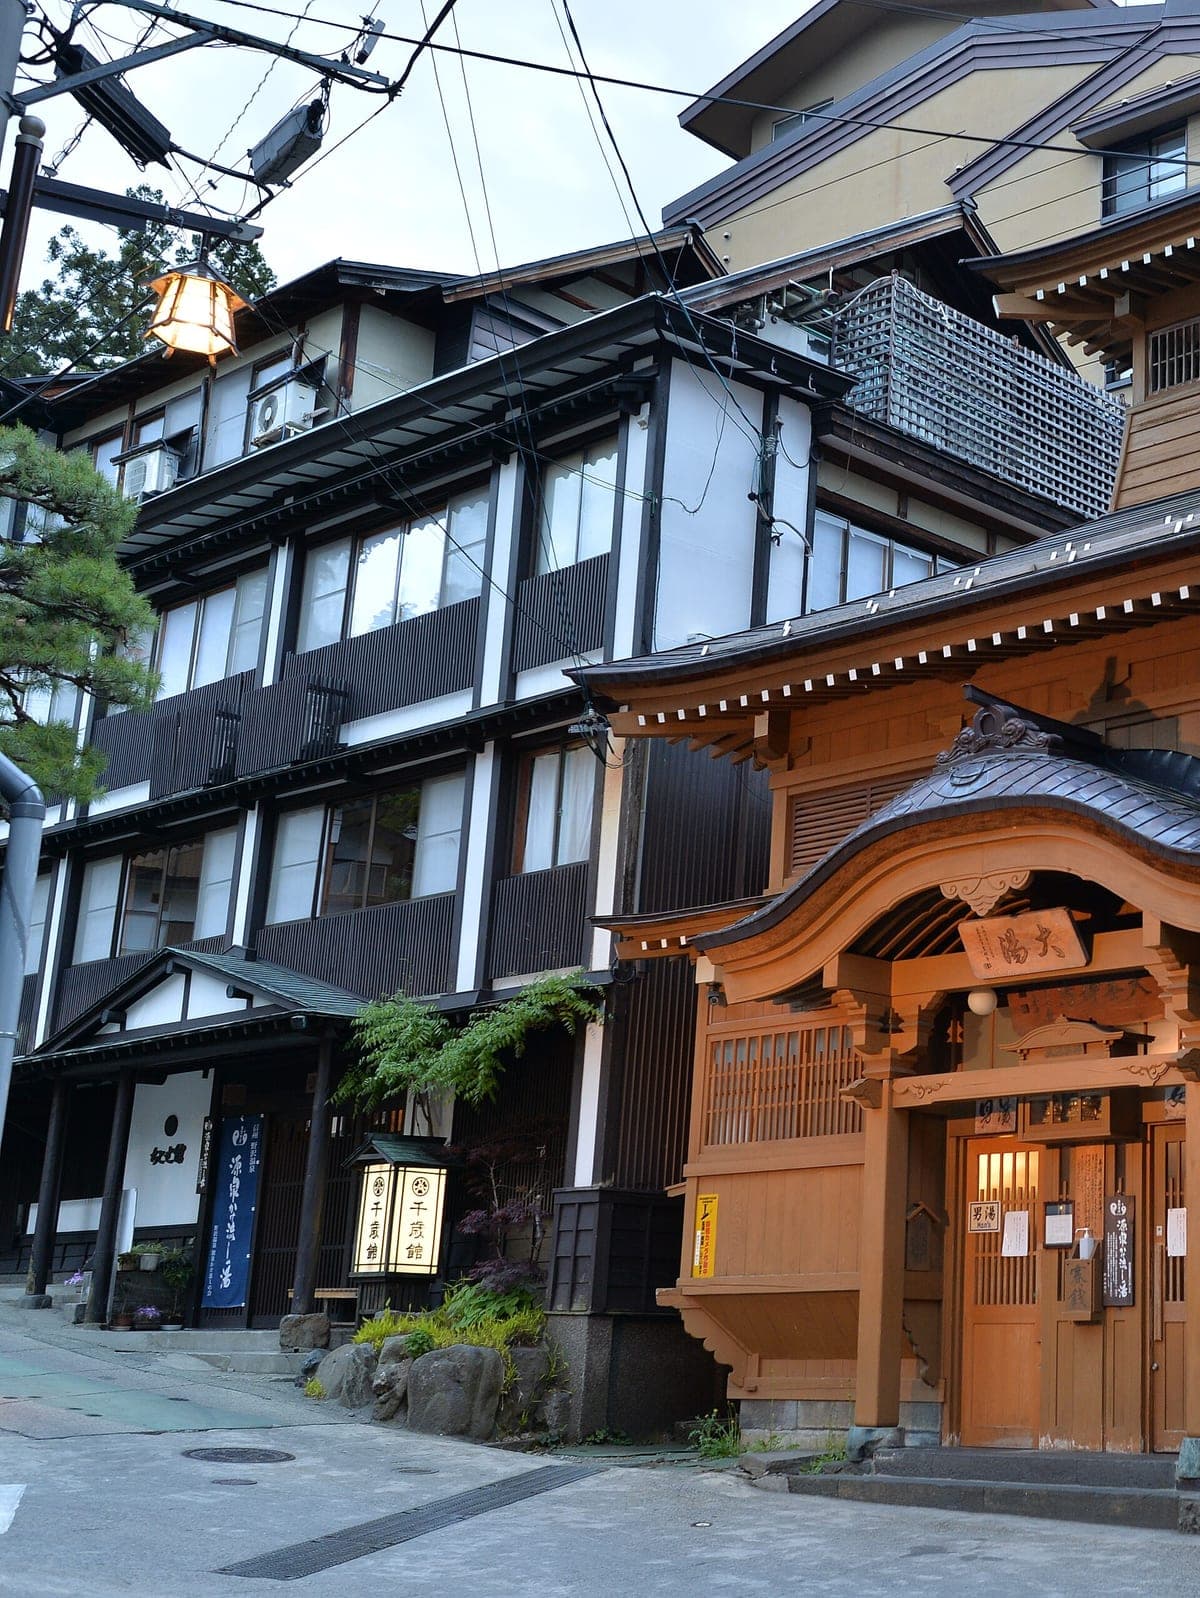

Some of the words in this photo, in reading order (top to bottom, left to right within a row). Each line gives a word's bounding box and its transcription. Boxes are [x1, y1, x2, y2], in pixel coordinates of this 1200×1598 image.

[405, 1201, 428, 1260] 千歳館
[973, 1205, 996, 1221] 男湯
